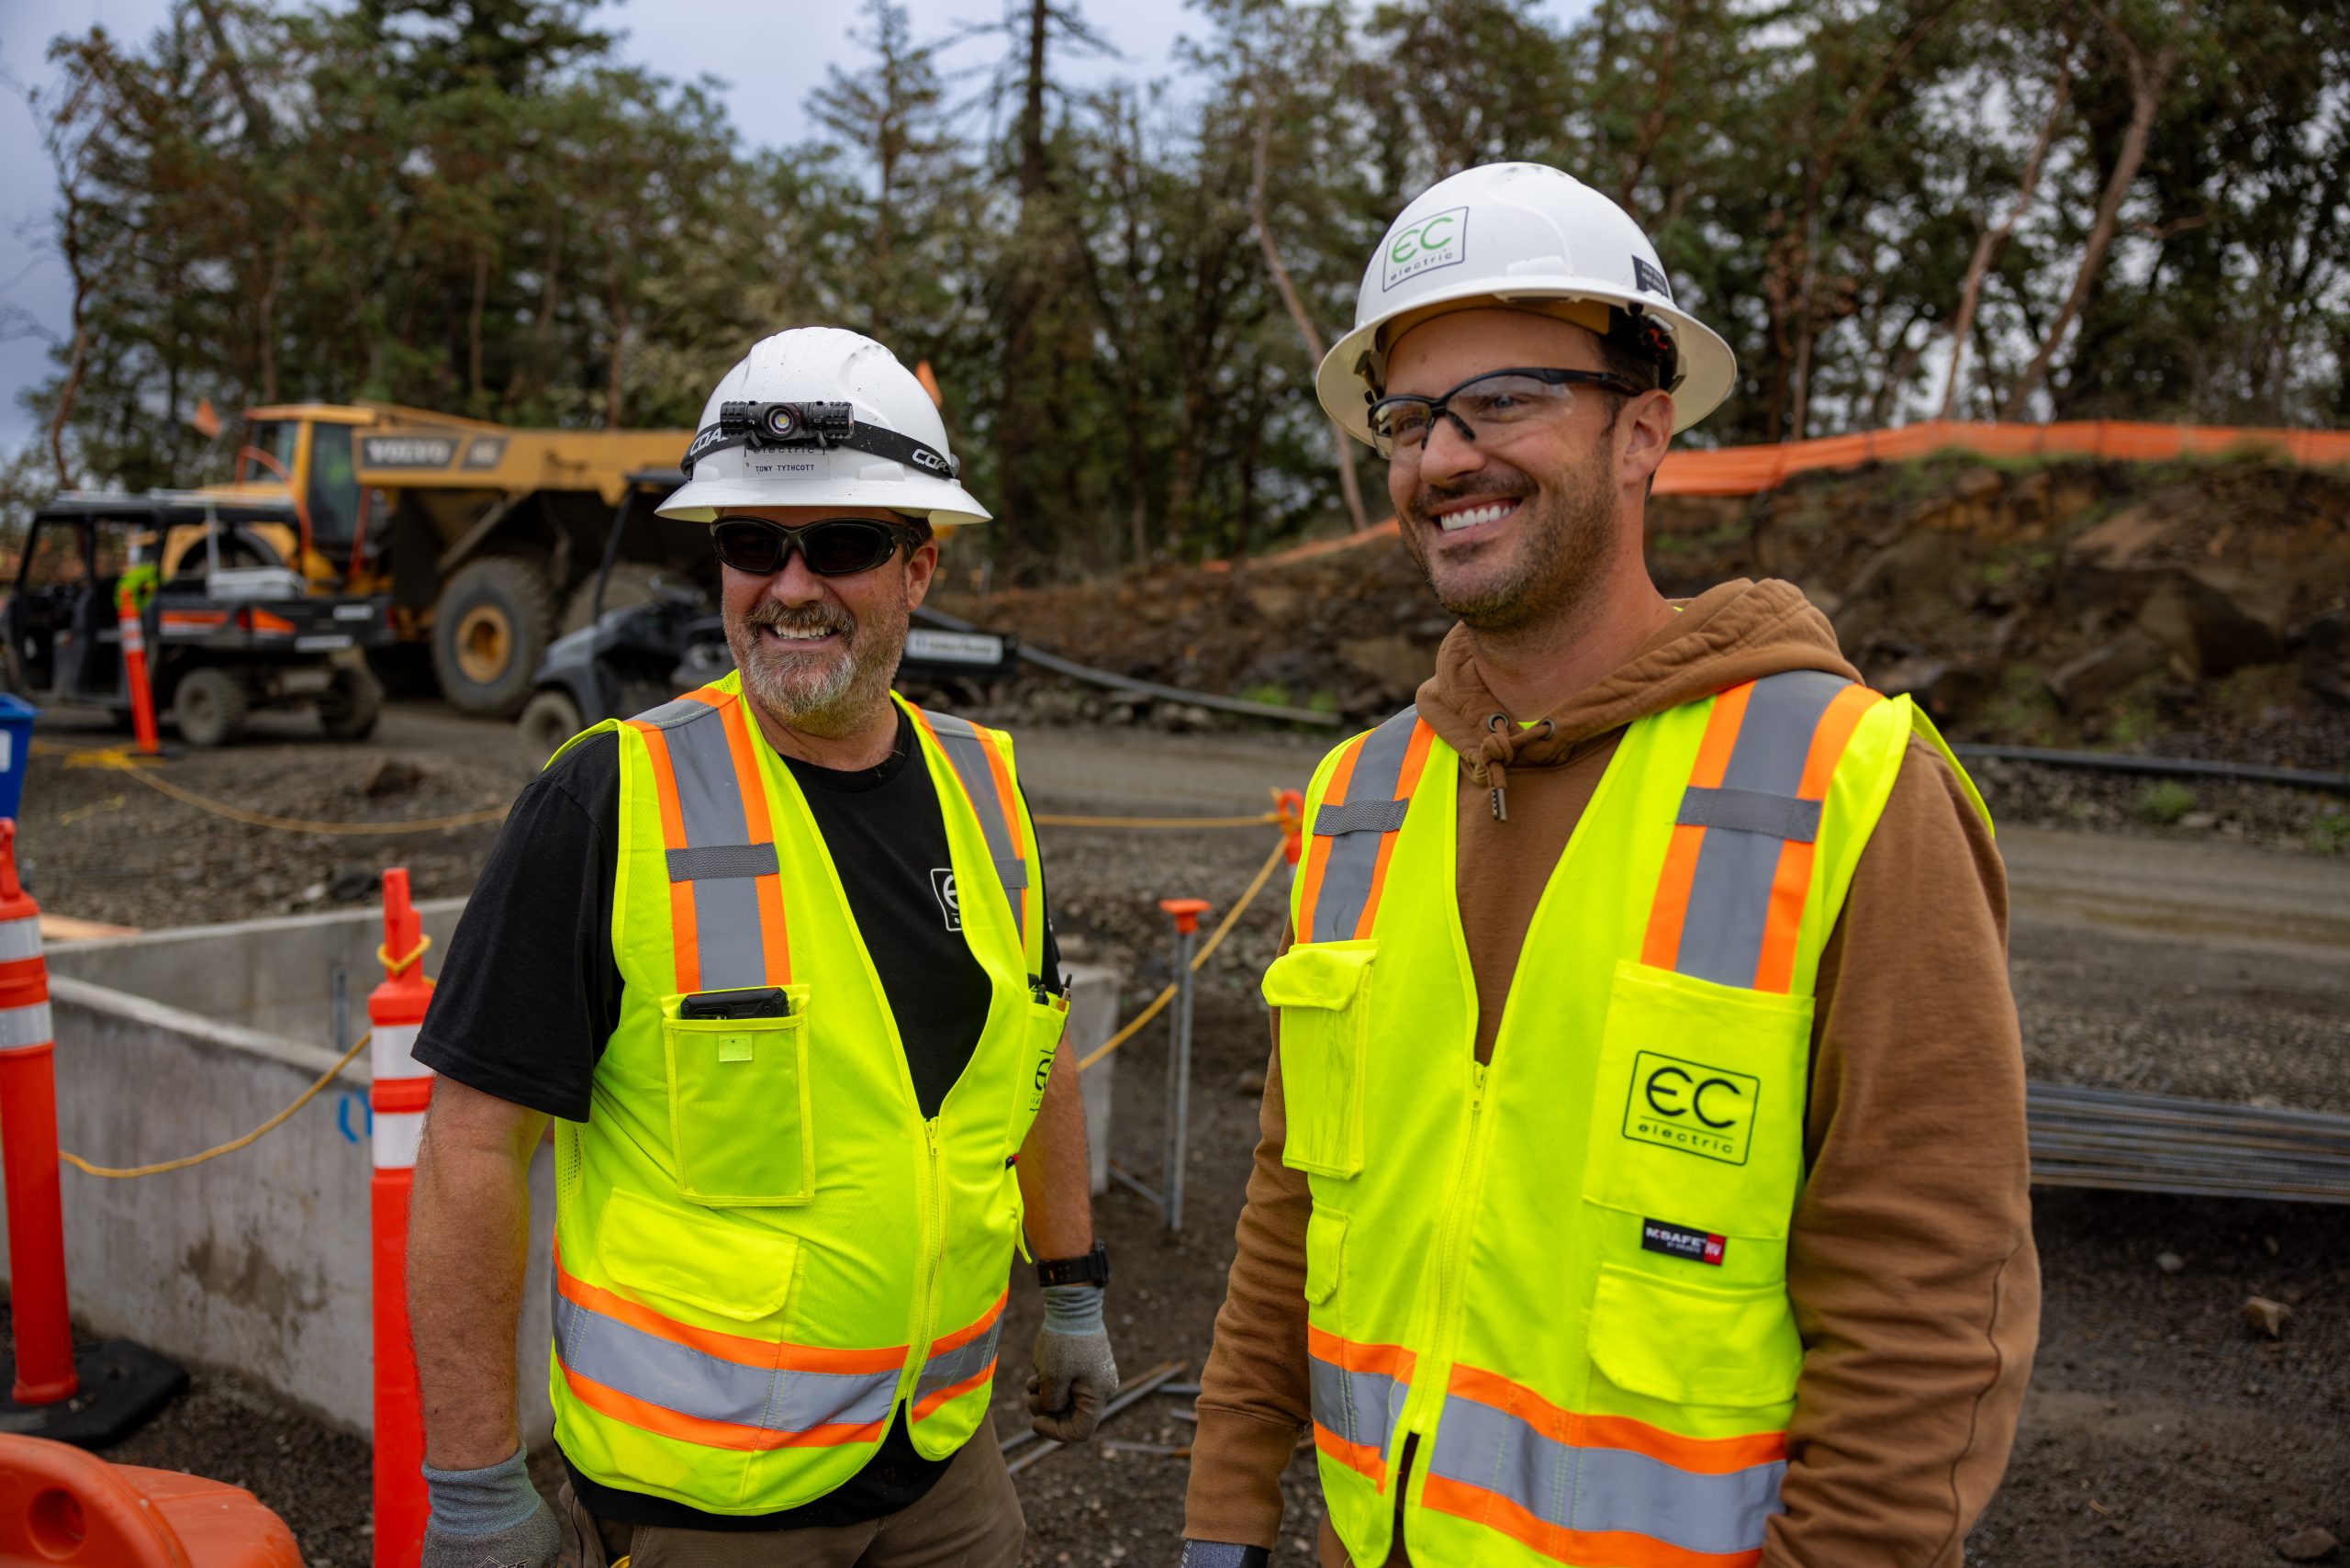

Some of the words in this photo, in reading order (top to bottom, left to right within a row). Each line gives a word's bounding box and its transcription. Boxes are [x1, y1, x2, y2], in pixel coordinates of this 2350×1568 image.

[1392, 217, 1454, 263] EC
[1391, 252, 1452, 281] electric
[690, 428, 728, 456] COA
[912, 448, 947, 472] COA
[1646, 1066, 1741, 1128] EC
[1638, 1123, 1733, 1154] electric
